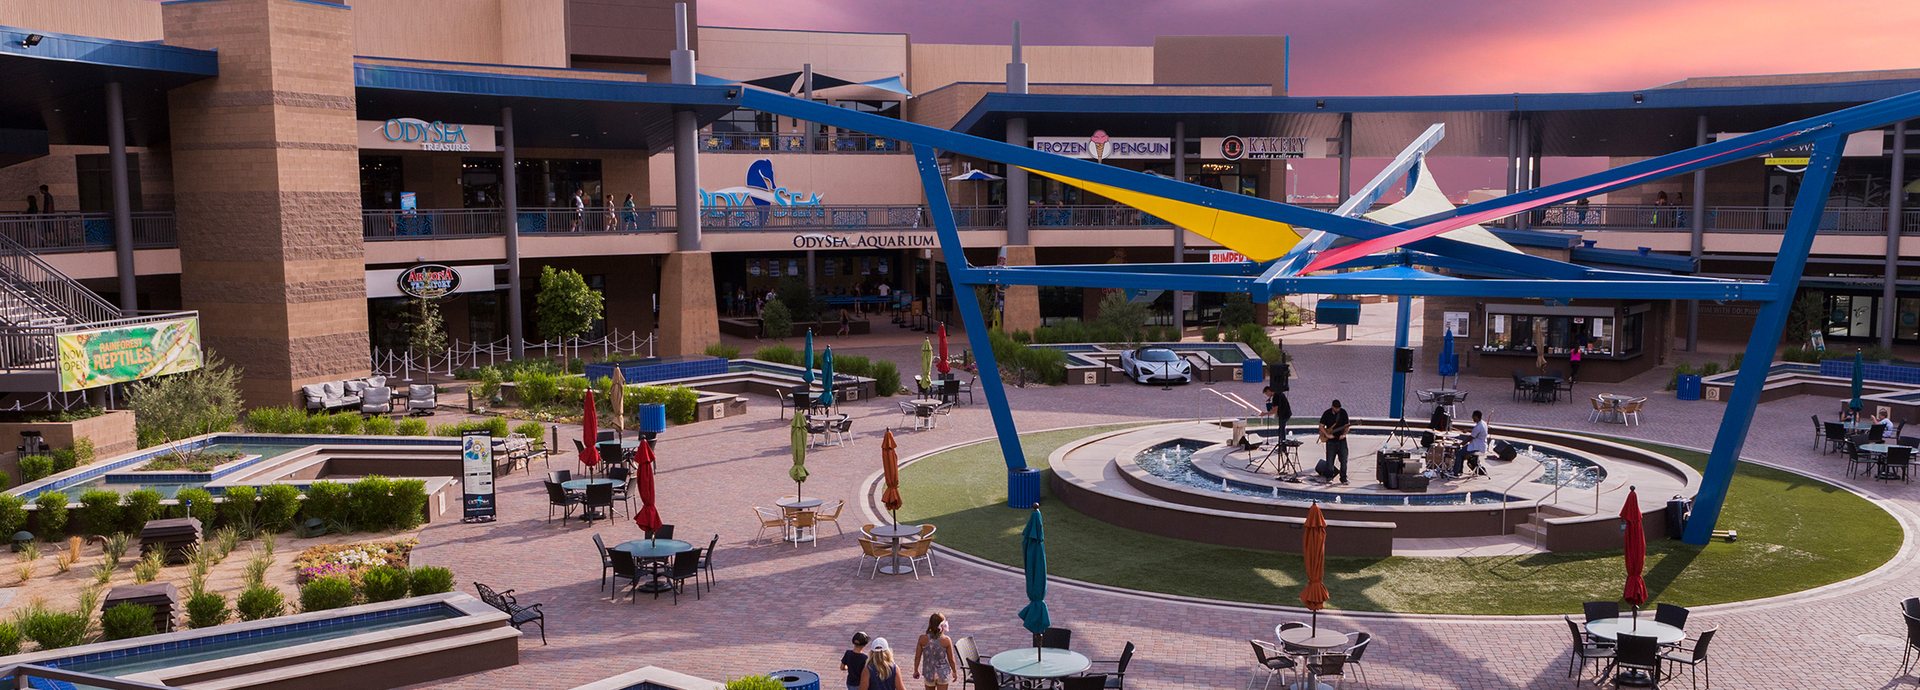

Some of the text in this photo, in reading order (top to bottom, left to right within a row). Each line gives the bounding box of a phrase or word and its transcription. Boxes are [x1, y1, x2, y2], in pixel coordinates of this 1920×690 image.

[422, 142, 471, 152] TREASURES
[1037, 142, 1169, 154] FROZEN PENGUIN
[1248, 137, 1307, 152] KAKERY
[857, 235, 935, 249] AQUARIUM
[100, 338, 143, 352] RAINFOREST
[63, 349, 85, 361] NOW
[93, 347, 154, 371] REPTILES
[63, 360, 87, 372] OPEN
